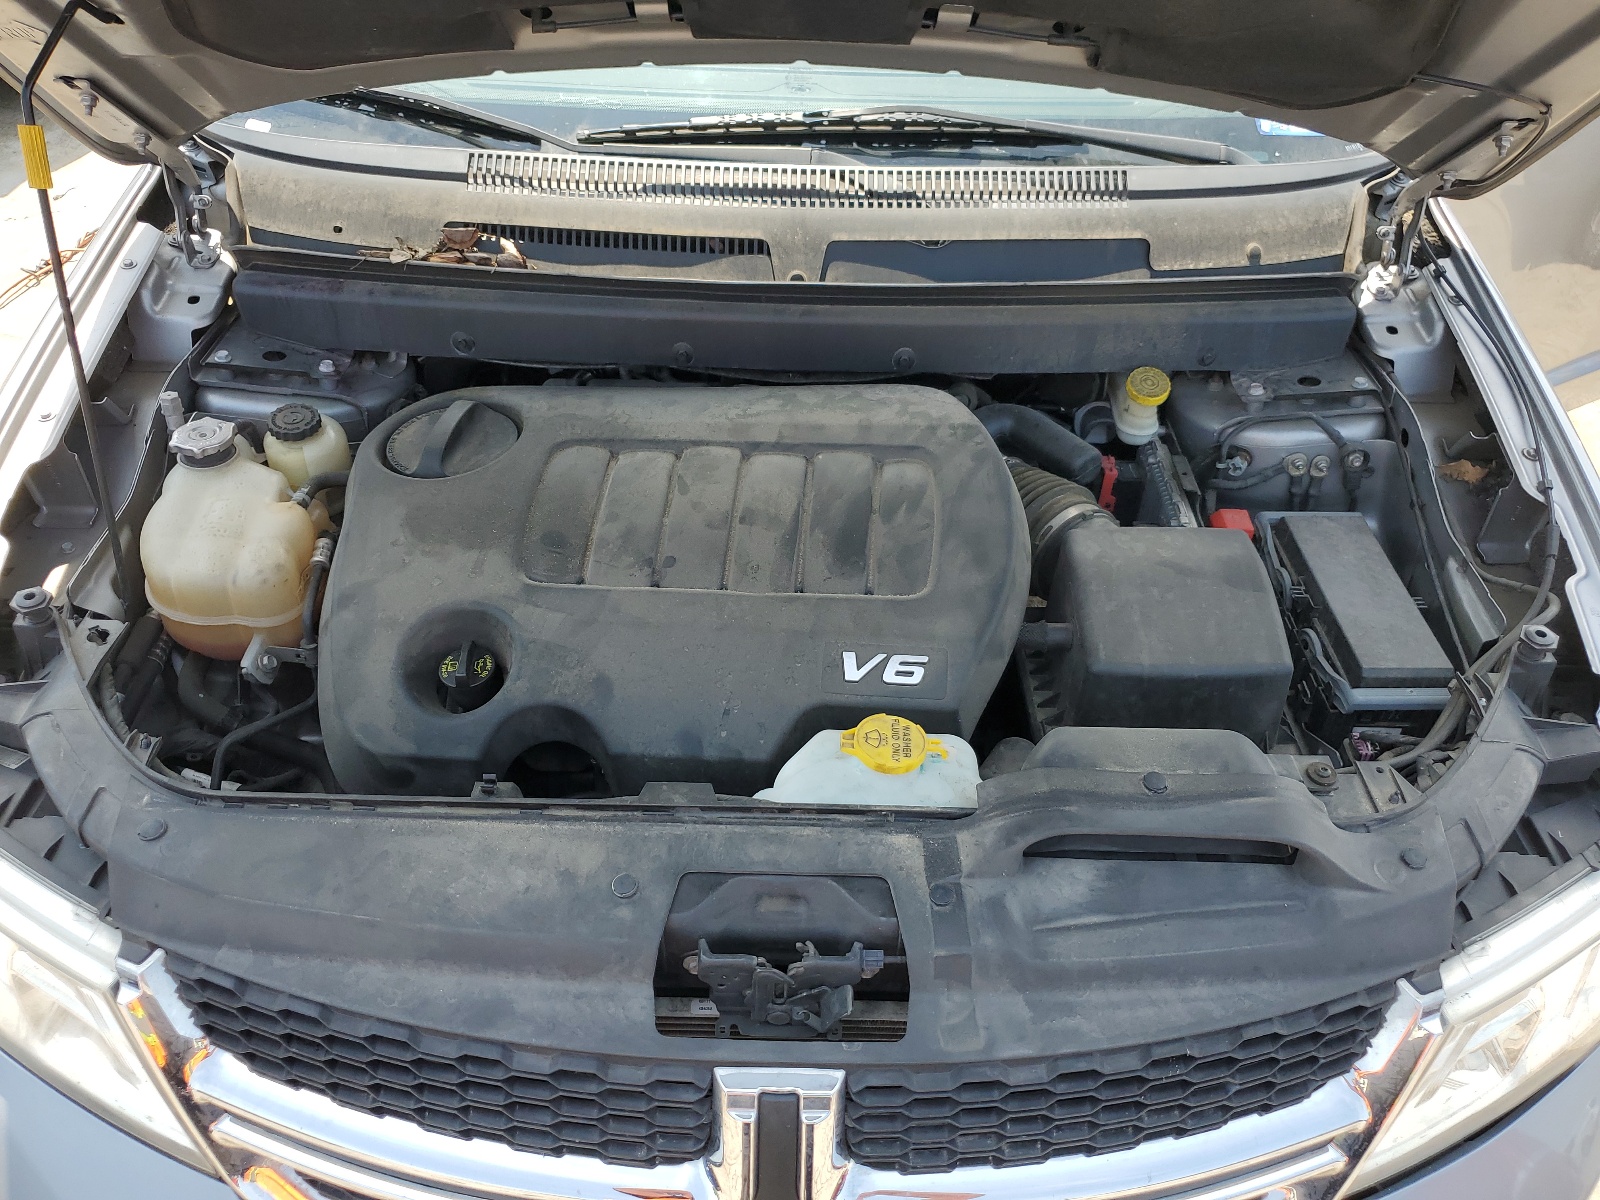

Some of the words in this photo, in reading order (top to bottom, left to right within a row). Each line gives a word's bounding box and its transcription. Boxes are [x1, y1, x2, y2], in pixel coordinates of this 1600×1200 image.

[842, 651, 929, 685] V6
[891, 718, 900, 740] FLUID
[902, 725, 912, 758] WASHER
[891, 743, 900, 763] ONLY
